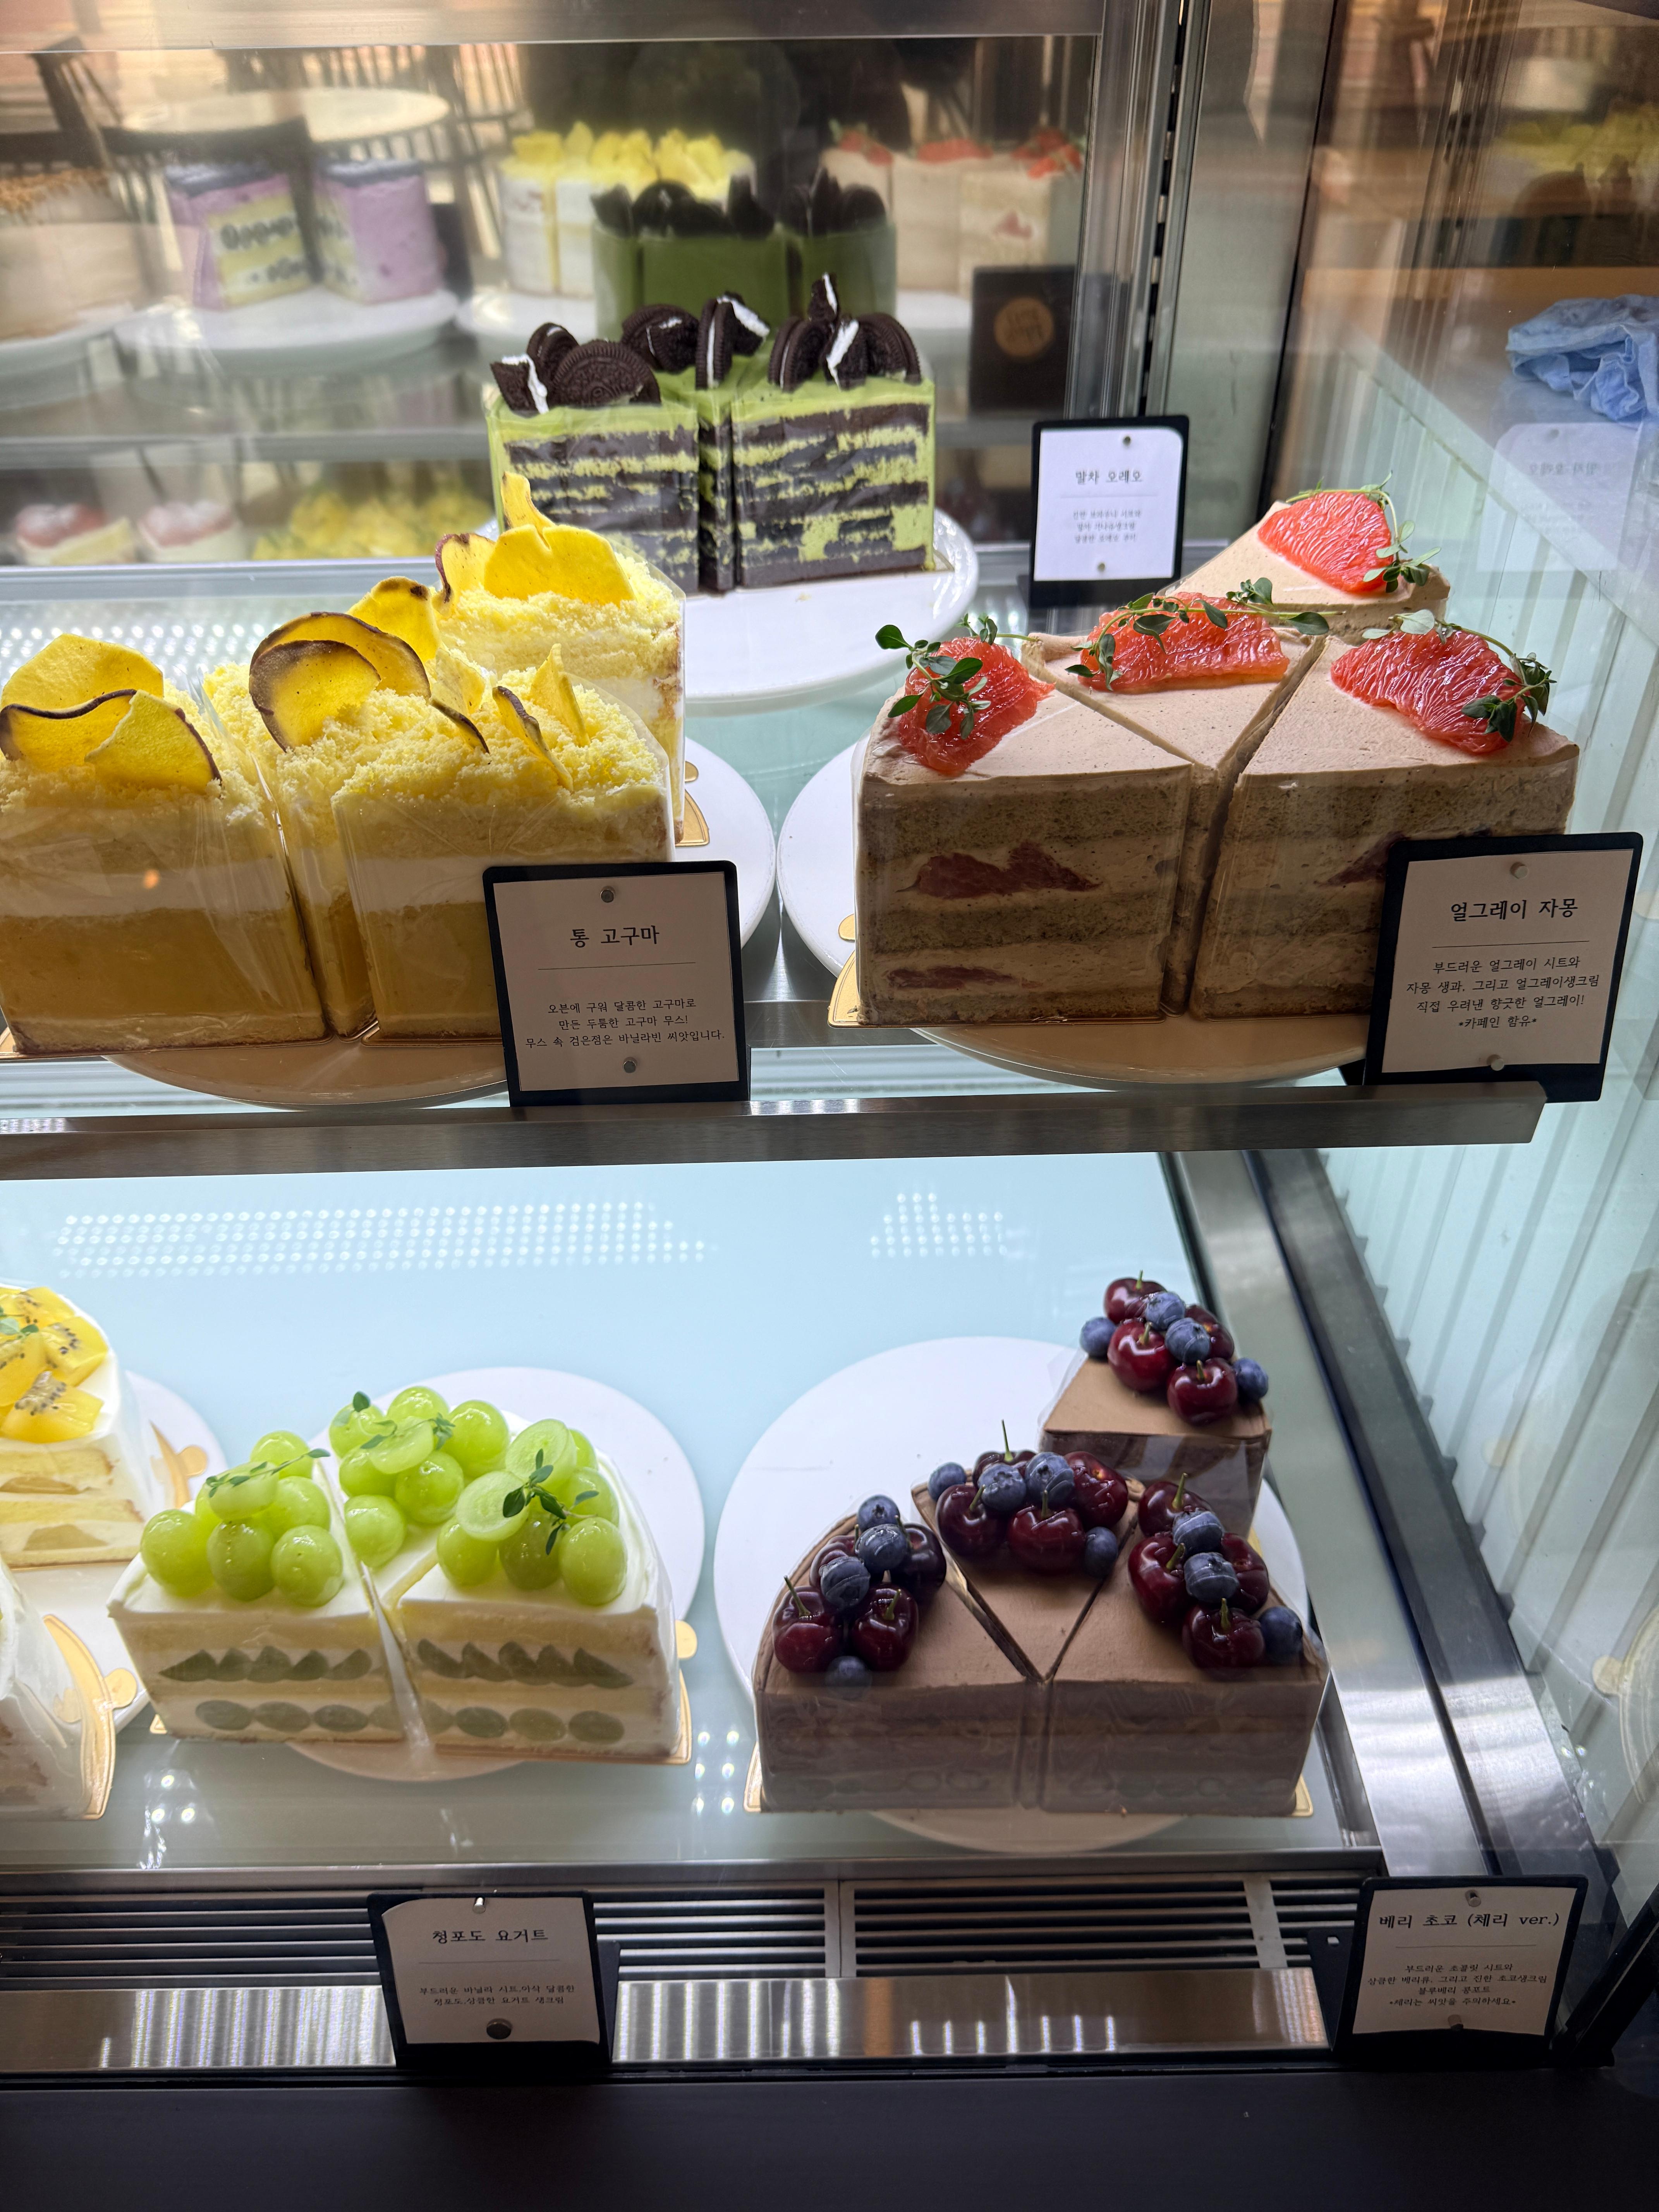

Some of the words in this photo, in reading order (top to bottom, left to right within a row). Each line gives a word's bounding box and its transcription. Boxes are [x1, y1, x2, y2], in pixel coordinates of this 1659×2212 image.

[1075, 470, 1099, 485] 말차
[1106, 469, 1143, 484] 오레오
[1451, 900, 1527, 922] 얼그레이
[1539, 898, 1578, 918] 자몽
[570, 929, 590, 948] 통
[601, 925, 660, 946] 고구마
[1432, 960, 1482, 974] 부드러운
[1489, 958, 1537, 972] 얼그레이
[1544, 956, 1580, 969] 시트와
[1406, 982, 1431, 994] 자몽
[1472, 979, 1509, 991] 그리고
[1516, 974, 1599, 990] 얼그레이생크림
[548, 1003, 580, 1014] 오븐에
[586, 1001, 607, 1013] 구워
[614, 1000, 646, 1012] 달콤한
[653, 998, 697, 1010] 고구마로
[1417, 1001, 1440, 1013] 직접
[1447, 999, 1483, 1012] 우려낸
[1491, 997, 1527, 1010] 향긋한
[1534, 994, 1584, 1008] 얼그레이!
[559, 1020, 580, 1030] 만든
[586, 1017, 619, 1029] 두툼한
[625, 1016, 657, 1027] 고구마
[663, 1015, 688, 1026] 무스!
[526, 1038, 548, 1049] 무스
[553, 1037, 563, 1048] 속
[570, 1035, 613, 1046] 검은점은
[618, 1032, 661, 1044] 바닐라빈
[667, 1029, 725, 1042] 씨앗입니다.
[1379, 1915, 1412, 1929] 베리
[1422, 1915, 1458, 1926] 초코
[1467, 1913, 1508, 1927] (체리
[1519, 1913, 1559, 1926] ver.)
[433, 1930, 486, 1944] 청포도
[495, 1929, 548, 1943] 요거트
[1405, 1965, 1444, 1973] 부드러운
[1449, 1964, 1478, 1972] 초콜릿
[1484, 1963, 1513, 1972] 시트와
[1473, 1975, 1492, 1983] 진한
[1497, 1975, 1547, 1984] 초코생크림
[419, 1987, 458, 1995] 부드러운
[464, 1986, 493, 1994] 바닐라
[1419, 1986, 1456, 1995] 블루베리
[535, 1996, 563, 2004] 생크림
[1427, 1998, 1457, 2006] 씨앗을
